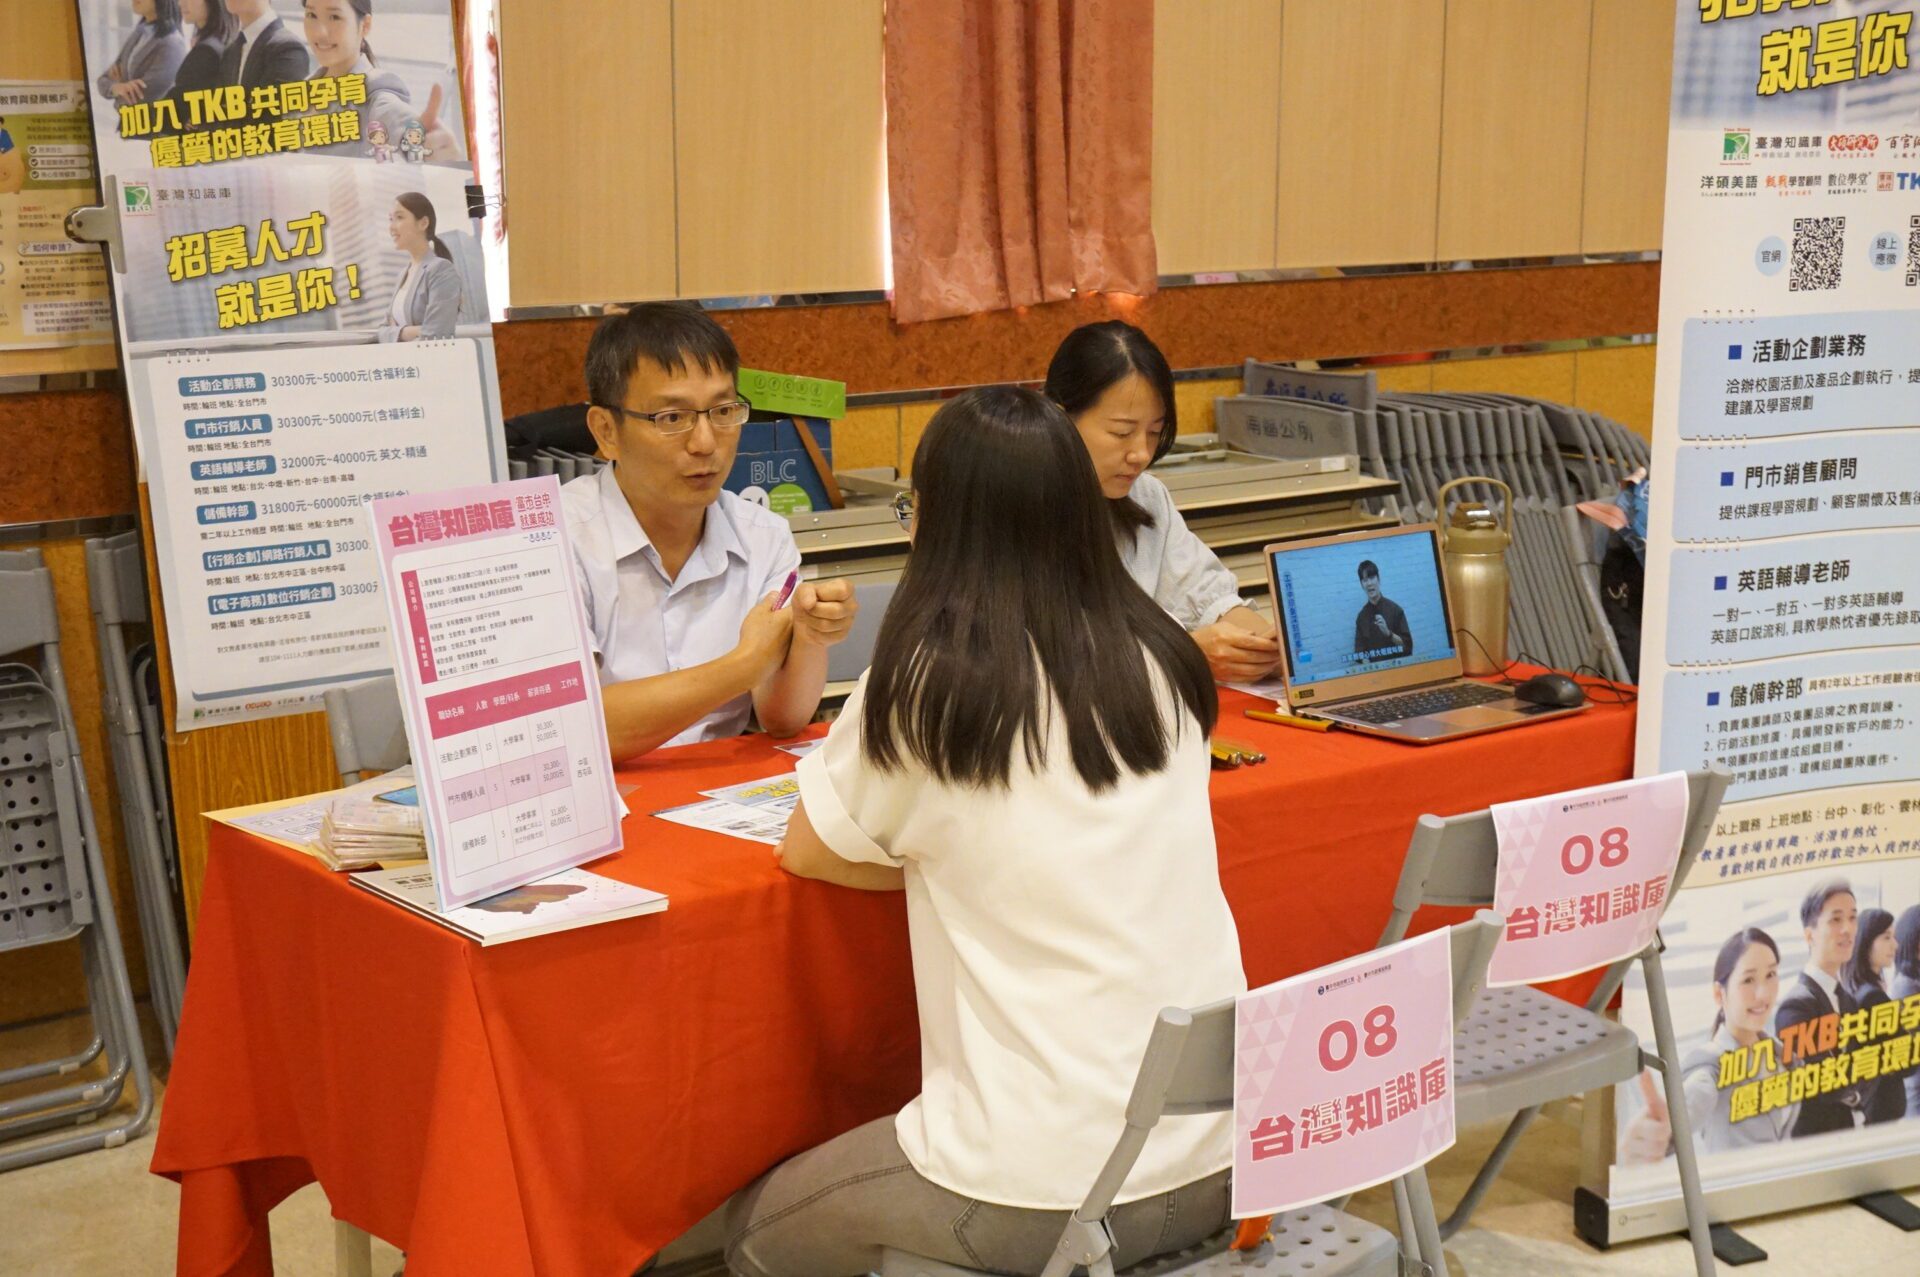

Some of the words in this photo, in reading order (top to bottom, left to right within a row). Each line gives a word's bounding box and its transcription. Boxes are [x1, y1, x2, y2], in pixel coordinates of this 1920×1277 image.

[1757, 11, 1914, 96] 就是你
[150, 111, 361, 169] 優質的教育環境
[1755, 136, 1823, 150] 臺灣知識庫
[1700, 175, 1758, 189] 洋碩美語
[1828, 172, 1869, 187] 數位學堂
[165, 211, 328, 283] 招募人才
[1761, 250, 1781, 263] 官網
[1752, 333, 1867, 363] 活動企劃業務
[188, 376, 257, 393] 活動企劃業務
[271, 366, 421, 387] 30300元~50000元(含福利金)
[1724, 395, 1814, 416] 建議及學習規劃
[194, 417, 263, 435] 門市行銷人員
[277, 407, 425, 429] 30300元~50000元(含福利金)
[199, 458, 268, 476] 英語輔導老師
[281, 450, 377, 469] 32000元~40000元
[750, 458, 797, 484] BLC
[1745, 457, 1858, 489] 門市銷售顧問
[204, 504, 249, 521] 儲備幹部
[388, 499, 516, 548] 台灣知識庫
[519, 511, 555, 529] 就業成功
[335, 539, 370, 553] 30300
[1737, 559, 1850, 592] 英語輔導老師
[1712, 590, 1904, 623] 一對一、一對五、一對多英語輔導
[475, 699, 489, 712] 人數
[1729, 677, 1803, 708] 儲備幹部
[1715, 817, 1762, 837] 以上職務
[1561, 827, 1629, 875] 08
[1505, 875, 1668, 942] 台灣知識庫
[1318, 1004, 1398, 1073] 08
[1249, 1057, 1446, 1162] 台灣知識庫
